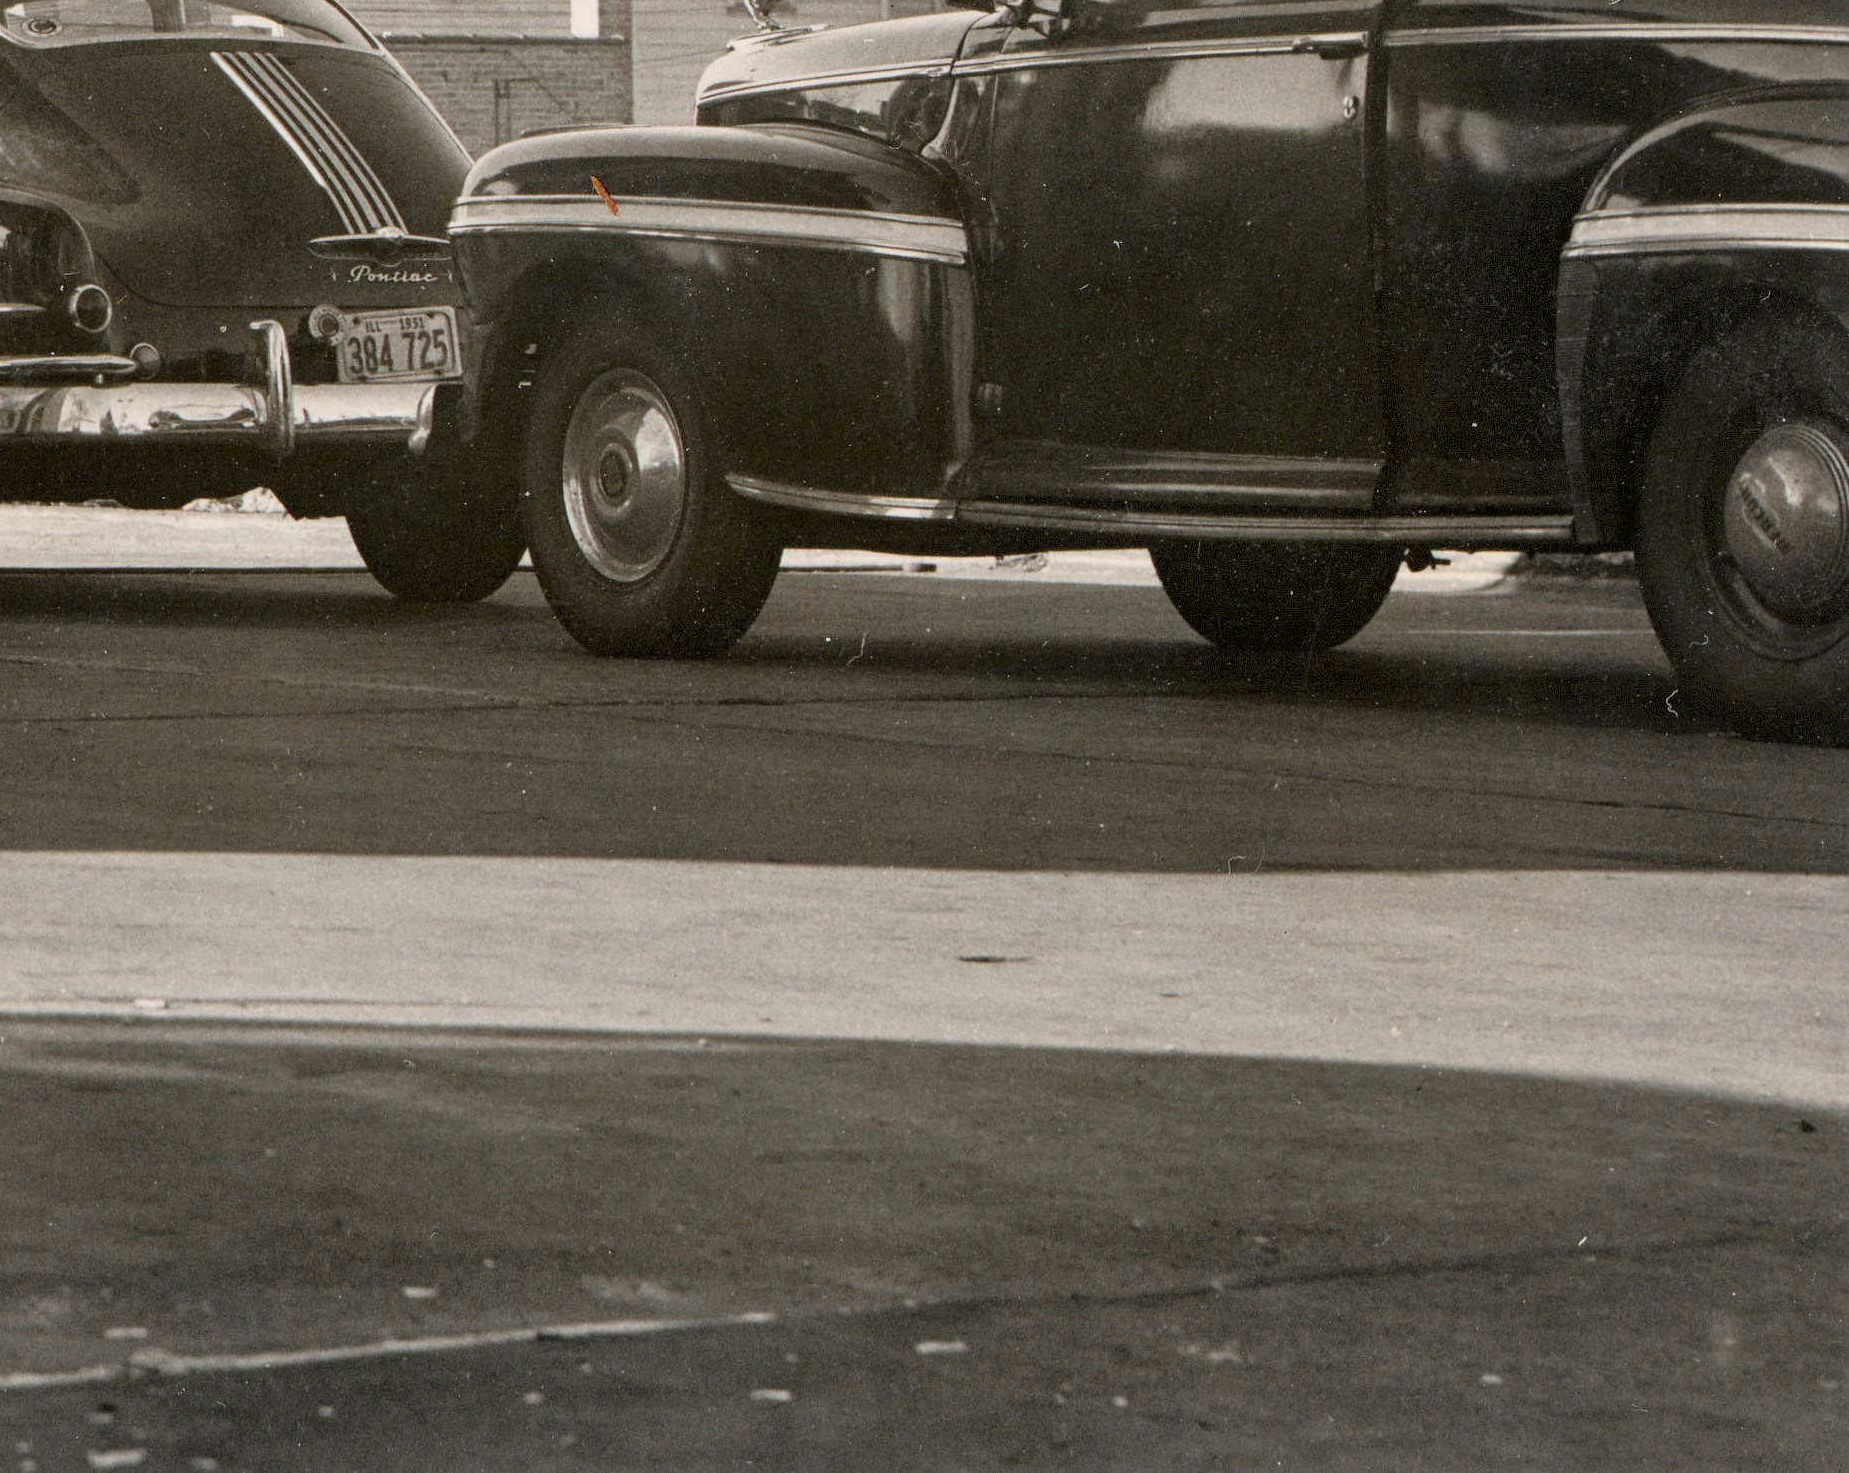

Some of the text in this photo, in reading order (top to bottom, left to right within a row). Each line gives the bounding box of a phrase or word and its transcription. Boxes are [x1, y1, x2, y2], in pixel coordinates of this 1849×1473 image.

[350, 264, 438, 283] Pontiac
[365, 316, 425, 333] ILL 1951
[347, 328, 448, 374] 384 725
